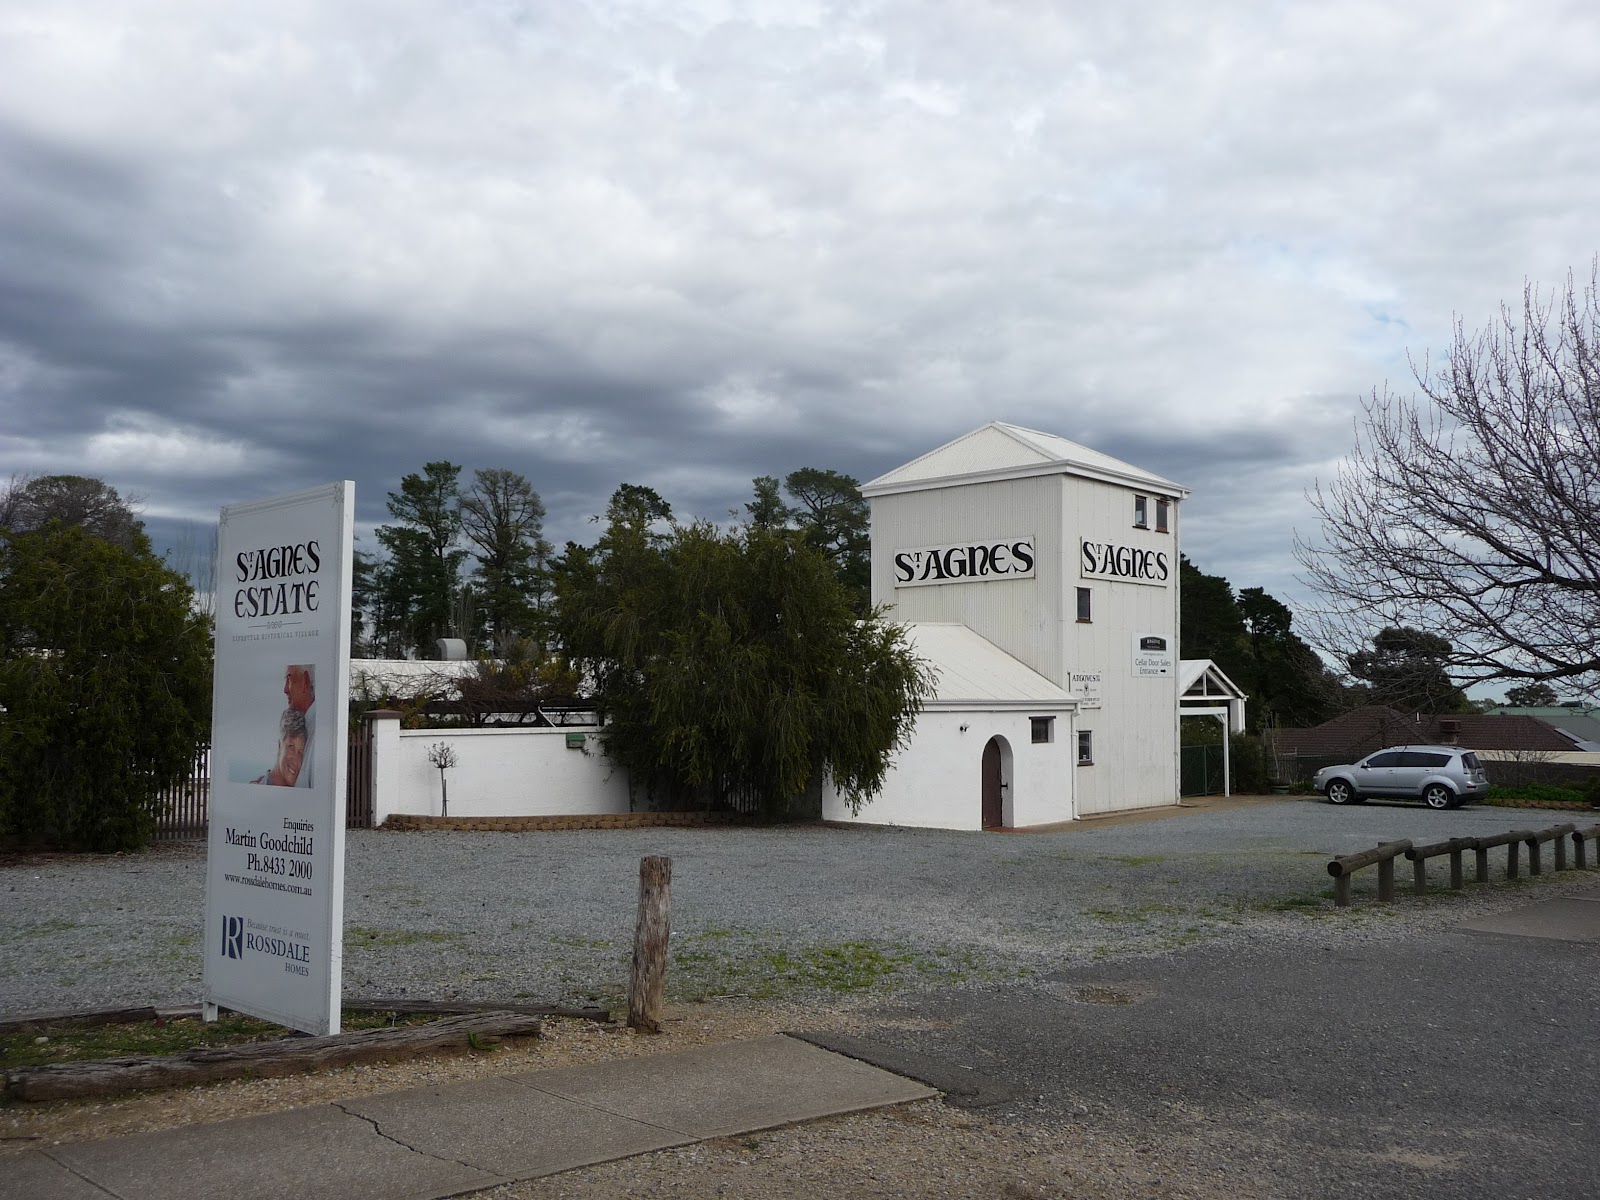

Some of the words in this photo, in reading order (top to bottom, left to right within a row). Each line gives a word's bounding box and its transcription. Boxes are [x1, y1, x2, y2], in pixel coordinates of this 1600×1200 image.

[235, 580, 320, 618] ESTATE
[1135, 658, 1148, 666] Cellar
[1148, 658, 1160, 667] Door
[1160, 658, 1171, 667] Sales
[1139, 667, 1159, 675] Entrance
[283, 817, 314, 833] Enquiries
[225, 828, 257, 848] Martin
[260, 832, 313, 855] Goodchild
[289, 859, 313, 880] 2000
[224, 873, 312, 896] www.rossdalehomes.com.au
[246, 932, 310, 963] ROSSDALE
[285, 962, 310, 976] HOMES
